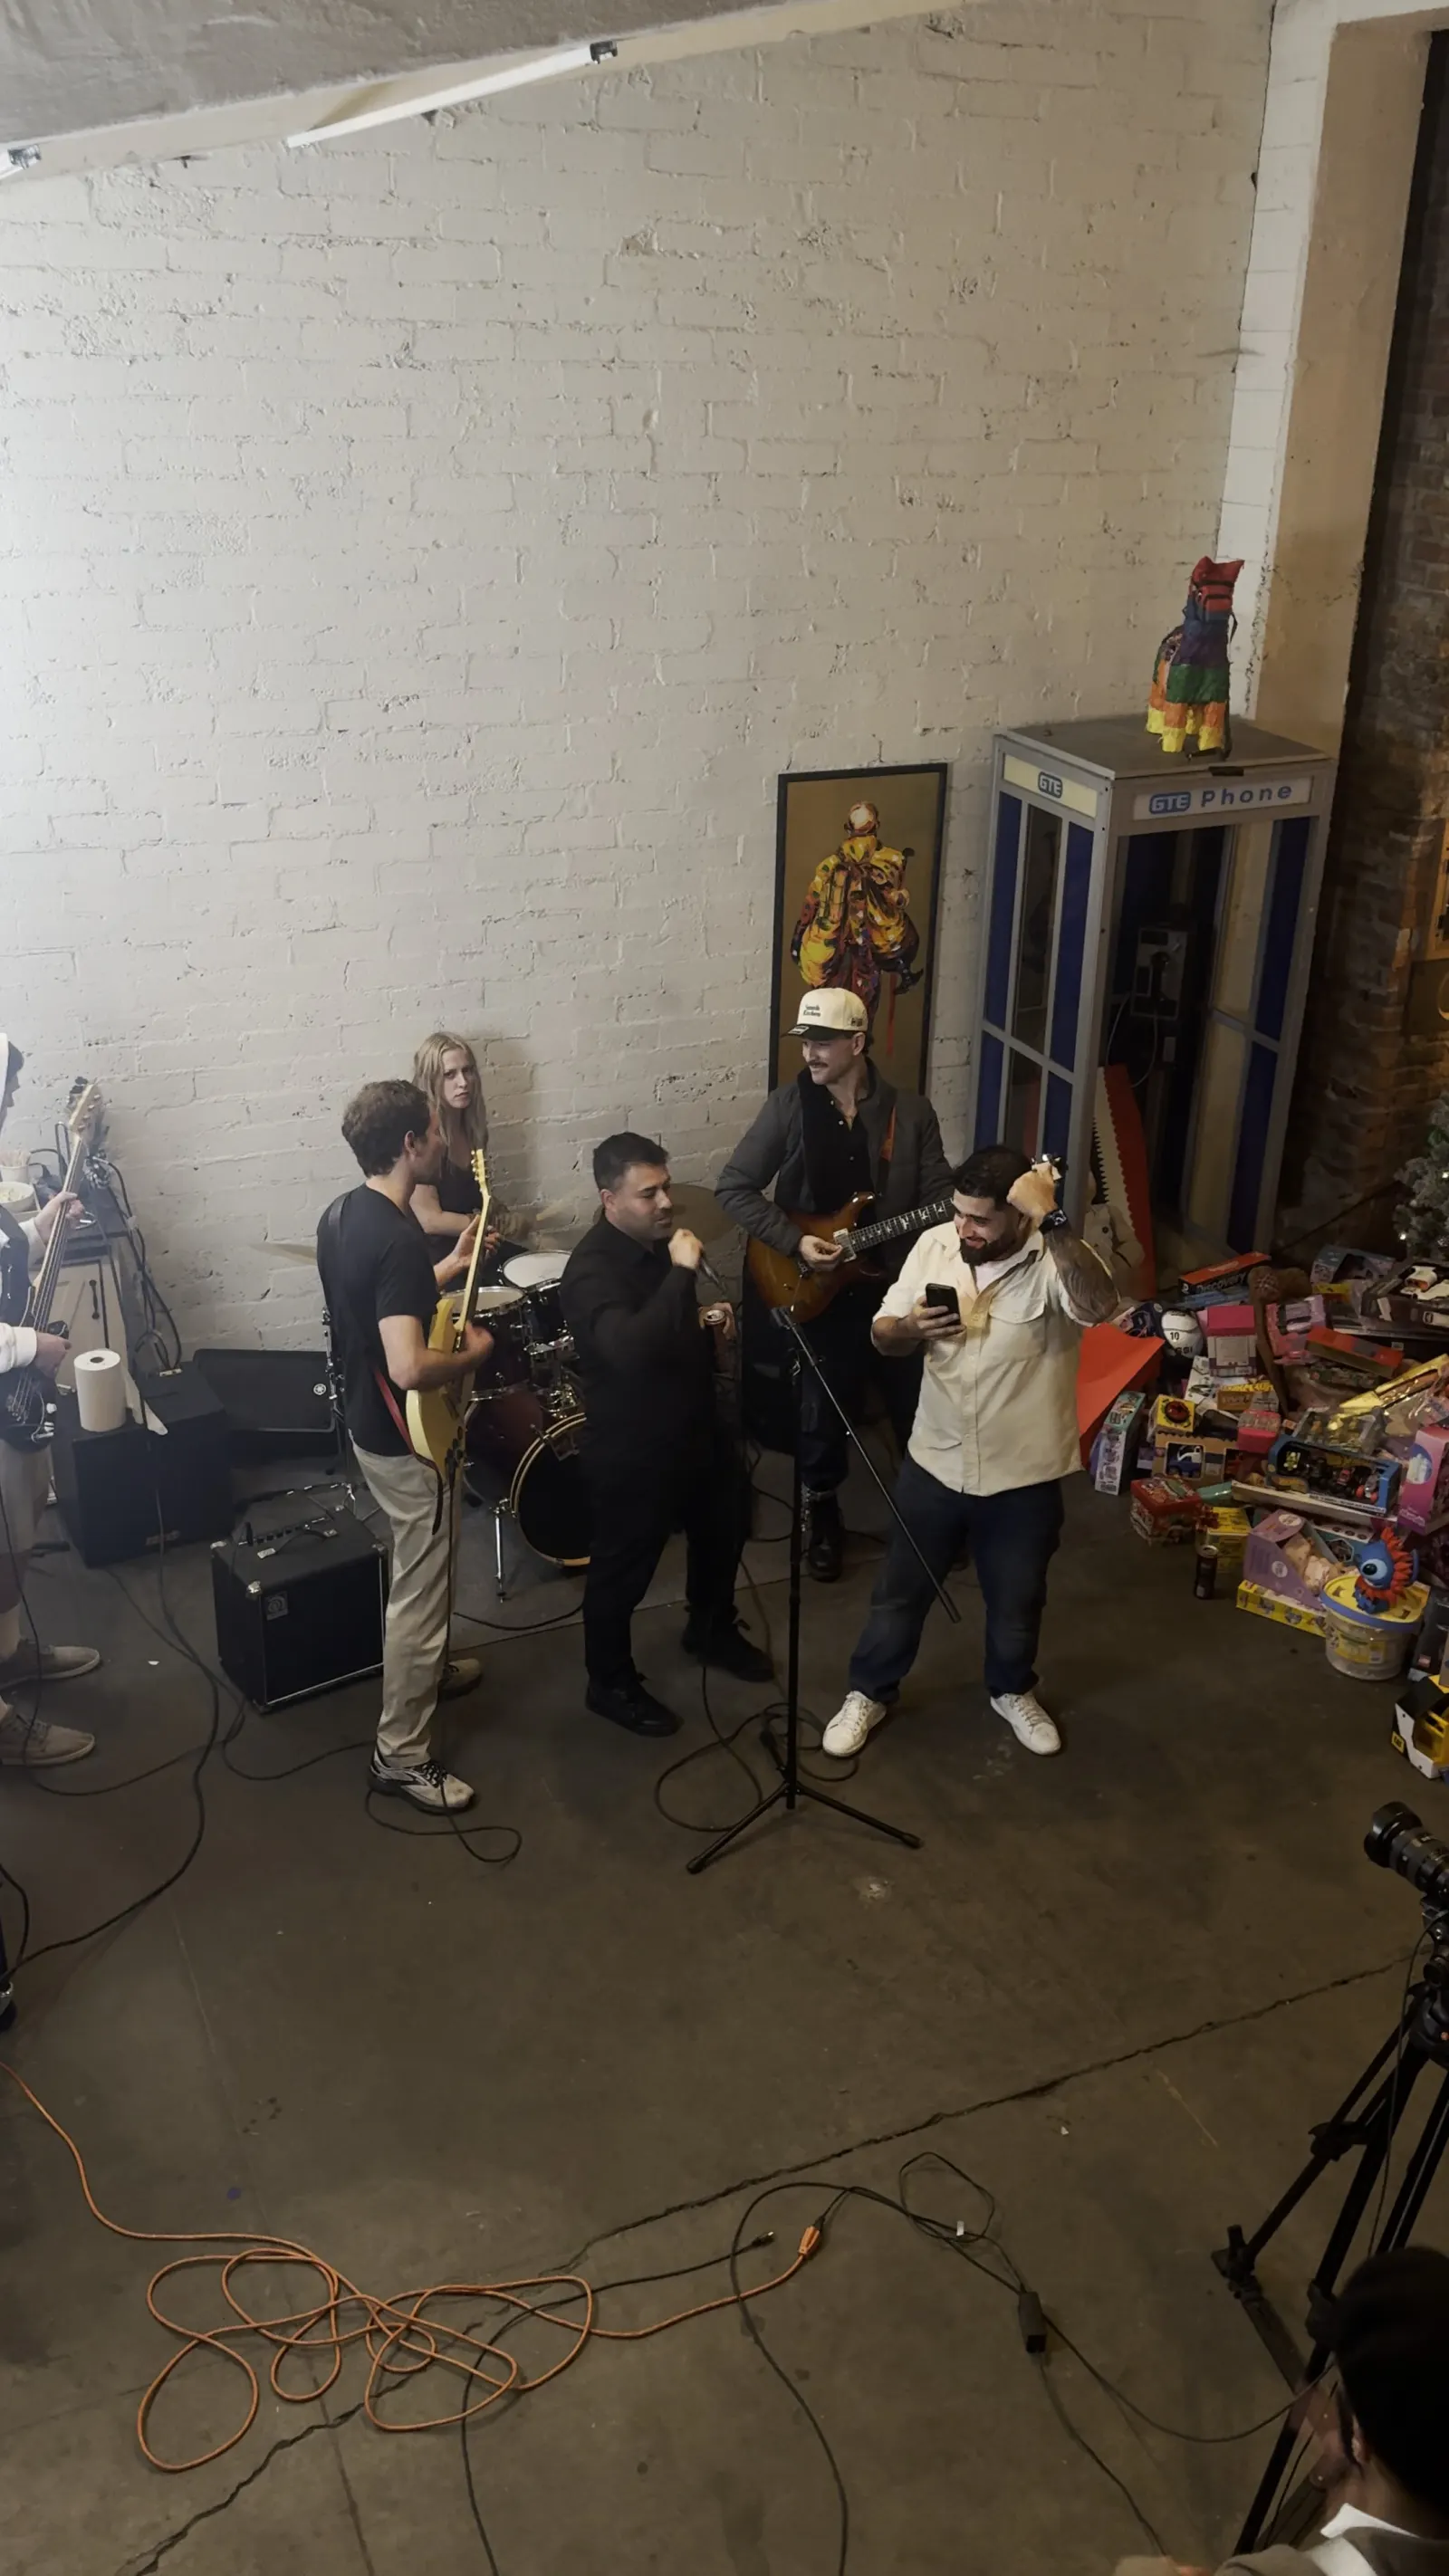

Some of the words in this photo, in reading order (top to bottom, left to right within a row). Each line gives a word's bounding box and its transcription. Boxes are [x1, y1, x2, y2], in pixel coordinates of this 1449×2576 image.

[1039, 774, 1061, 796] GTE
[1151, 794, 1189, 812] GTE
[1201, 785, 1292, 808] Phone
[1170, 1332, 1180, 1341] 10
